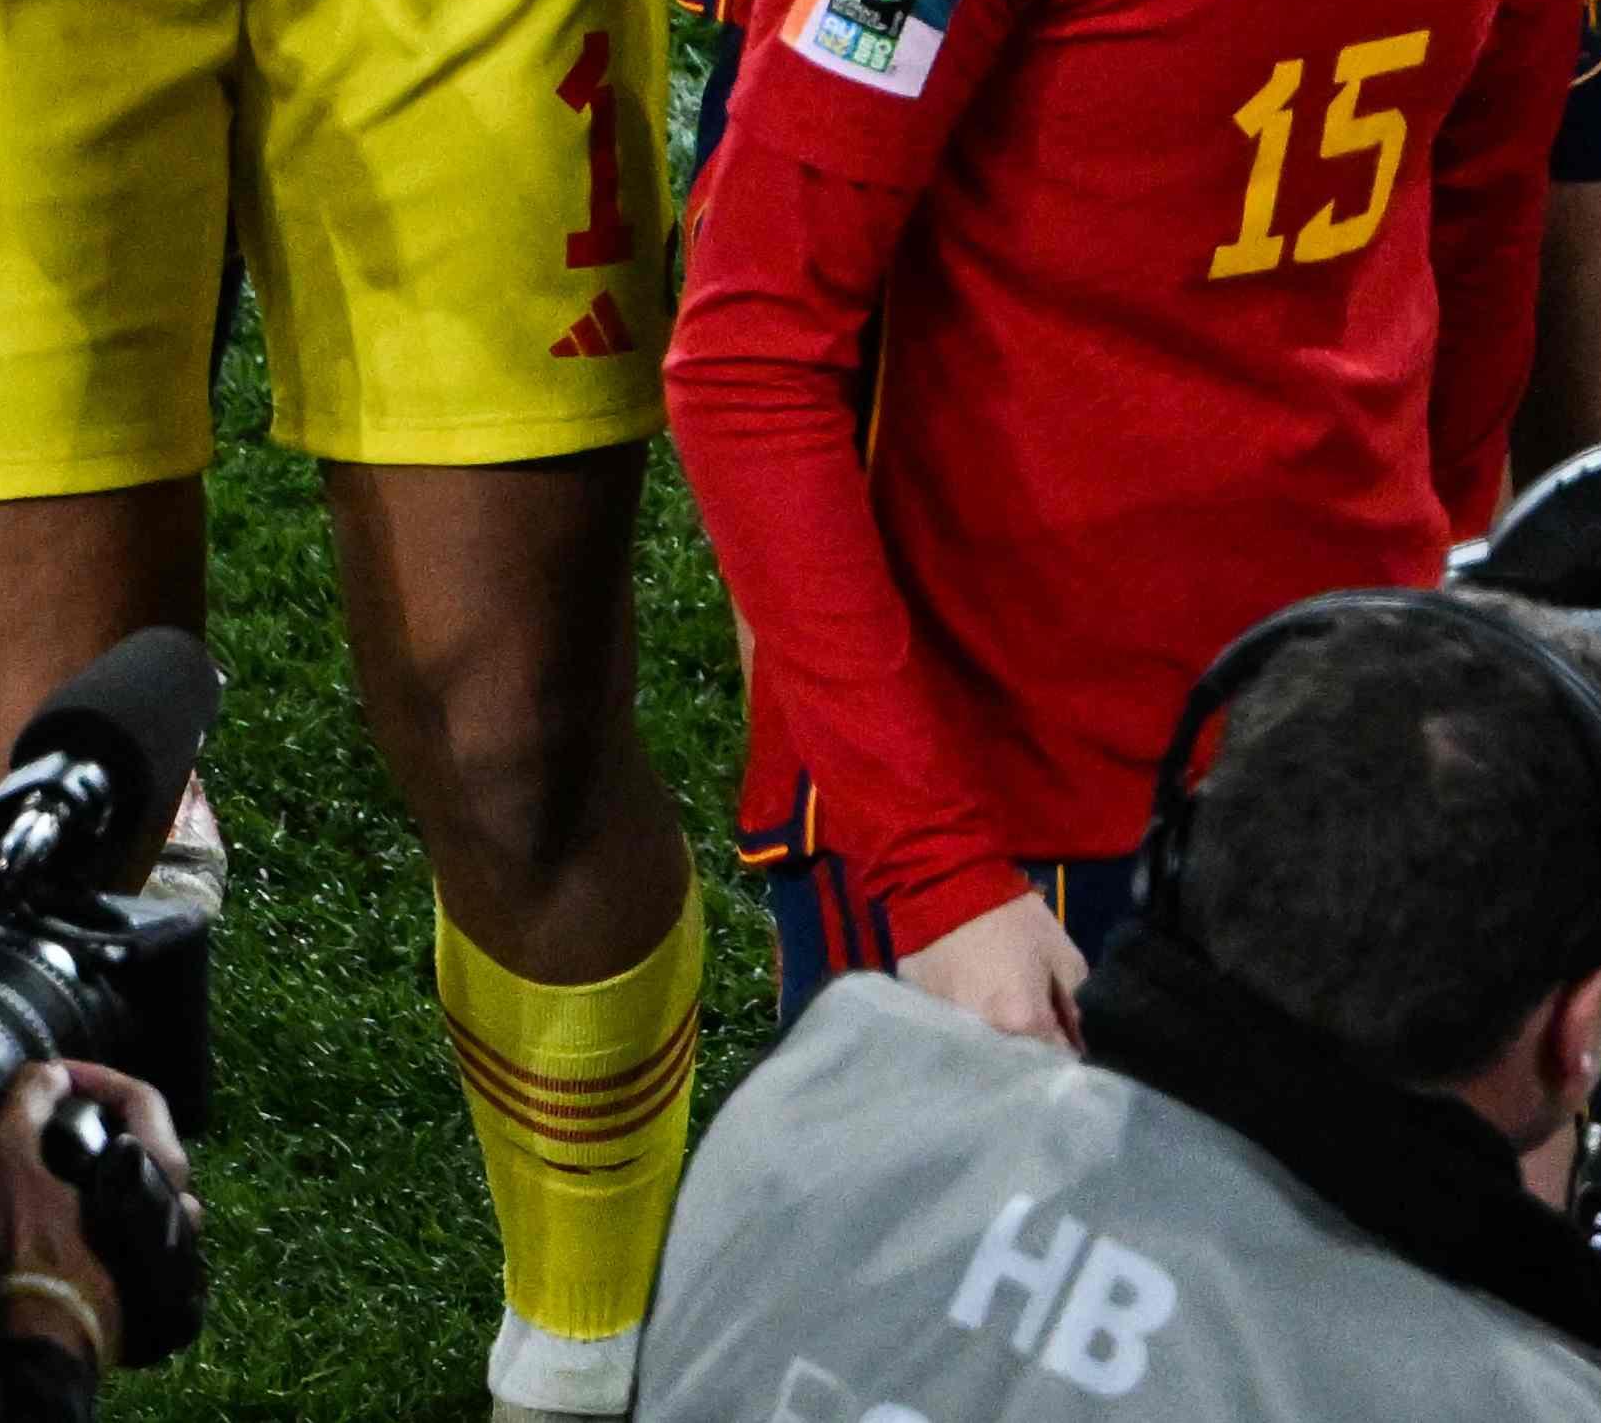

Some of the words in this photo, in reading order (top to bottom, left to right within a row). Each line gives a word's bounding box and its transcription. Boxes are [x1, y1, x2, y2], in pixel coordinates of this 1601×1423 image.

[554, 30, 636, 270] 1
[1208, 29, 1432, 281] 15
[947, 1192, 1179, 1396] HB
